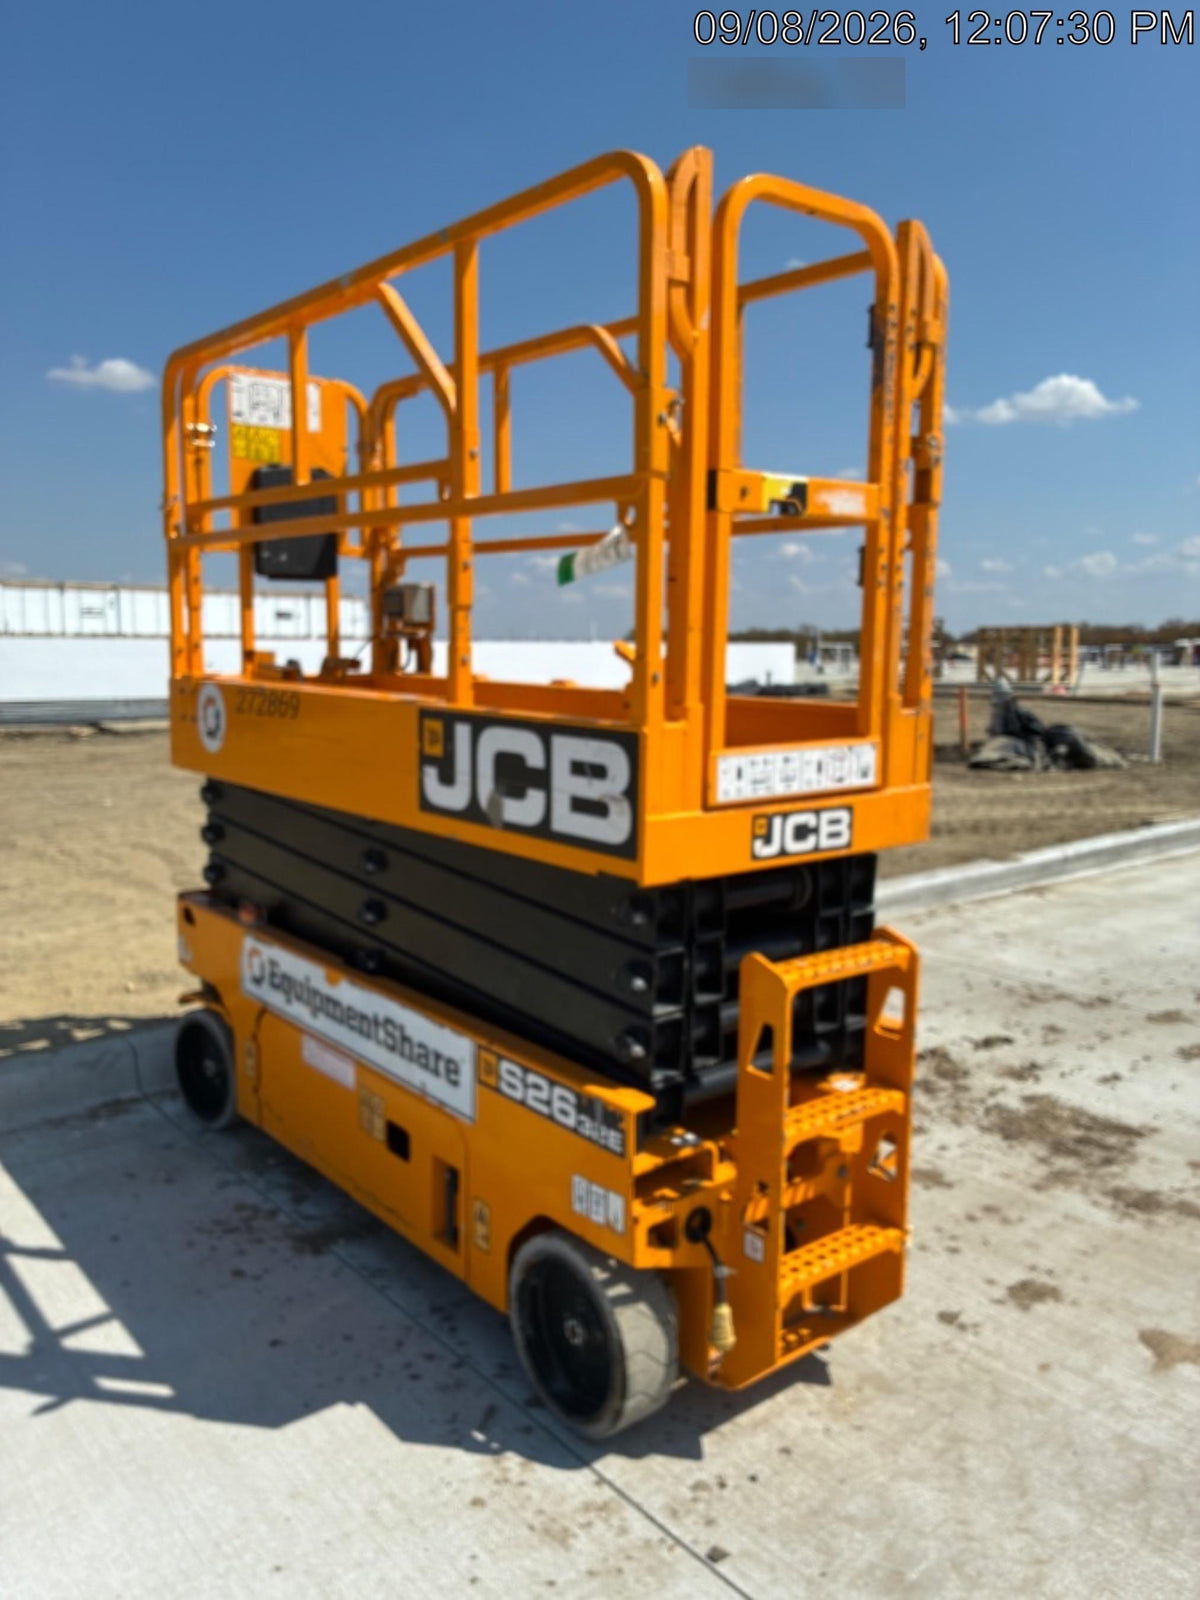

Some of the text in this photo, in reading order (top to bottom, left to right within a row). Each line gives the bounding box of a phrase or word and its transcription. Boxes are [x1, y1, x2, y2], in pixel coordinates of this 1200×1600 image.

[422, 721, 632, 846] JCB
[753, 808, 851, 858] JCB
[268, 957, 461, 1088] EquipmentShare
